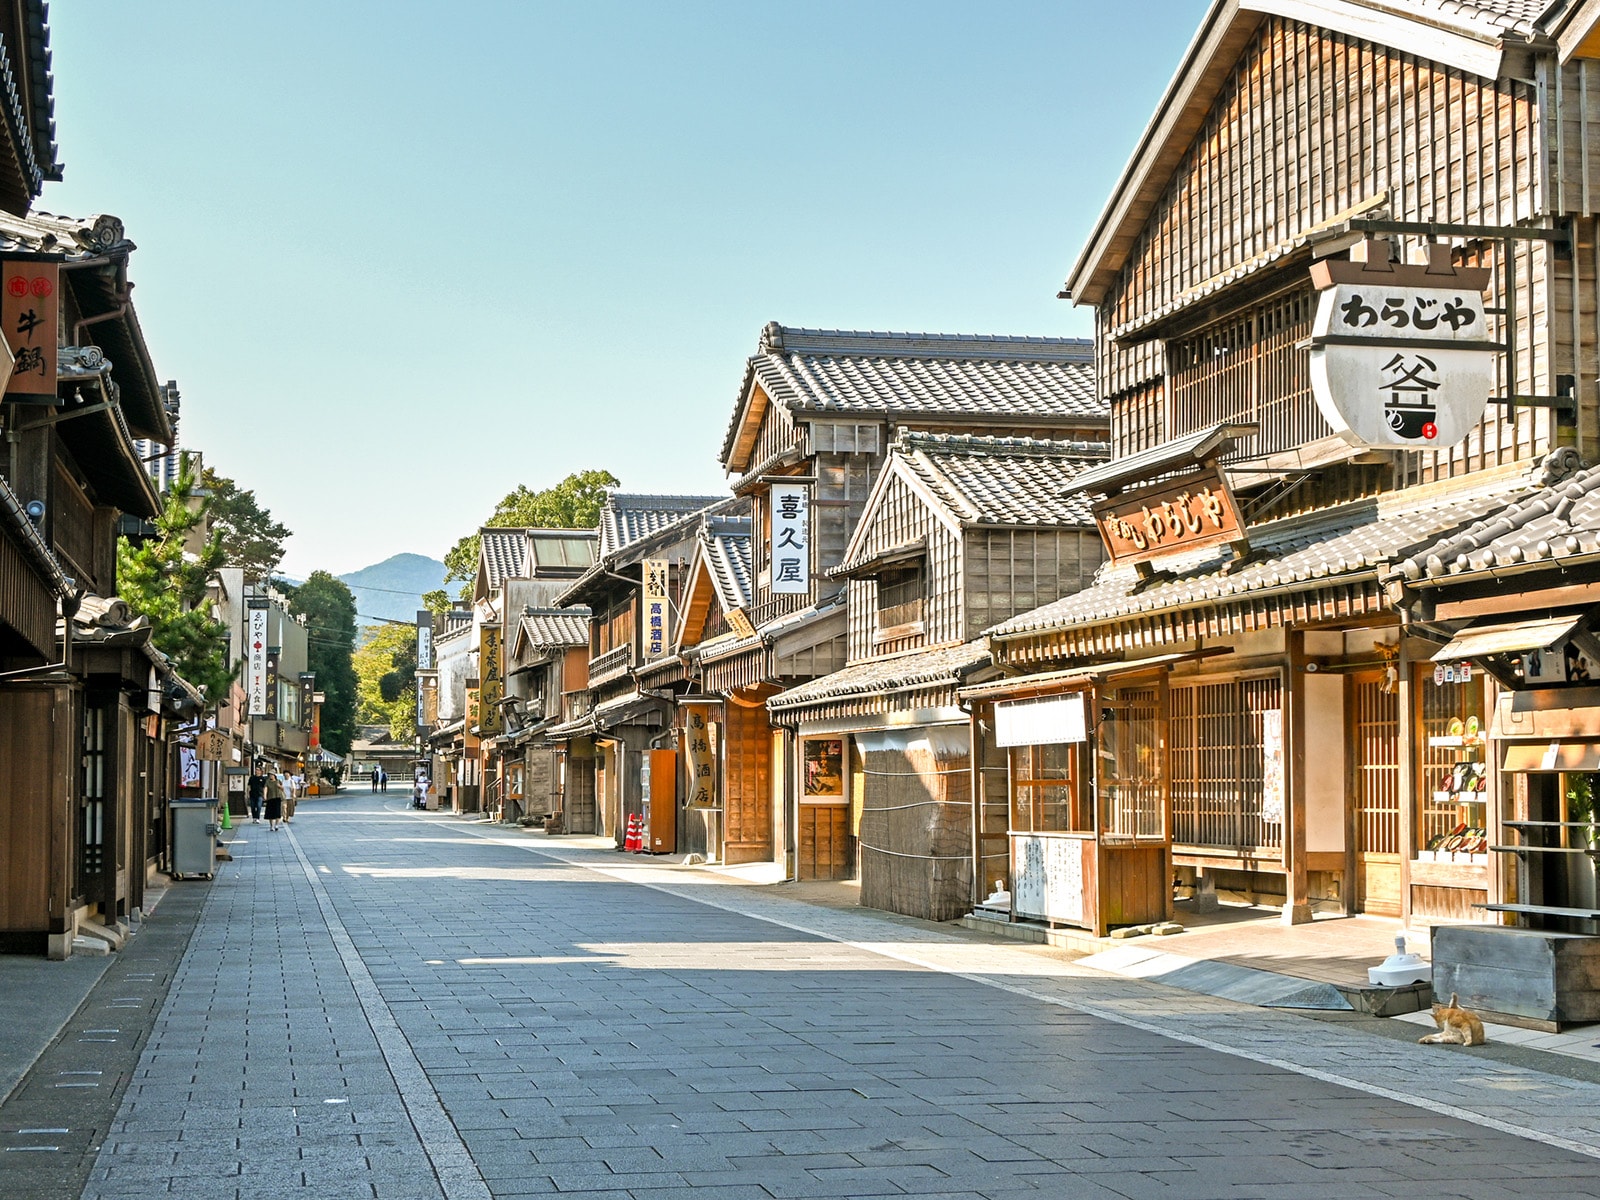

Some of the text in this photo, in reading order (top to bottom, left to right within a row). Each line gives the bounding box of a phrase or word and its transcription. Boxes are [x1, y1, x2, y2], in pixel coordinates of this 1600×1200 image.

[14, 308, 47, 377] 牛鍋
[1341, 294, 1476, 331] わらじや
[776, 494, 804, 583] 喜久屋
[1142, 486, 1224, 544] わらじや
[650, 603, 663, 653] 高橋酒店
[690, 713, 711, 803] 高橋酒店
